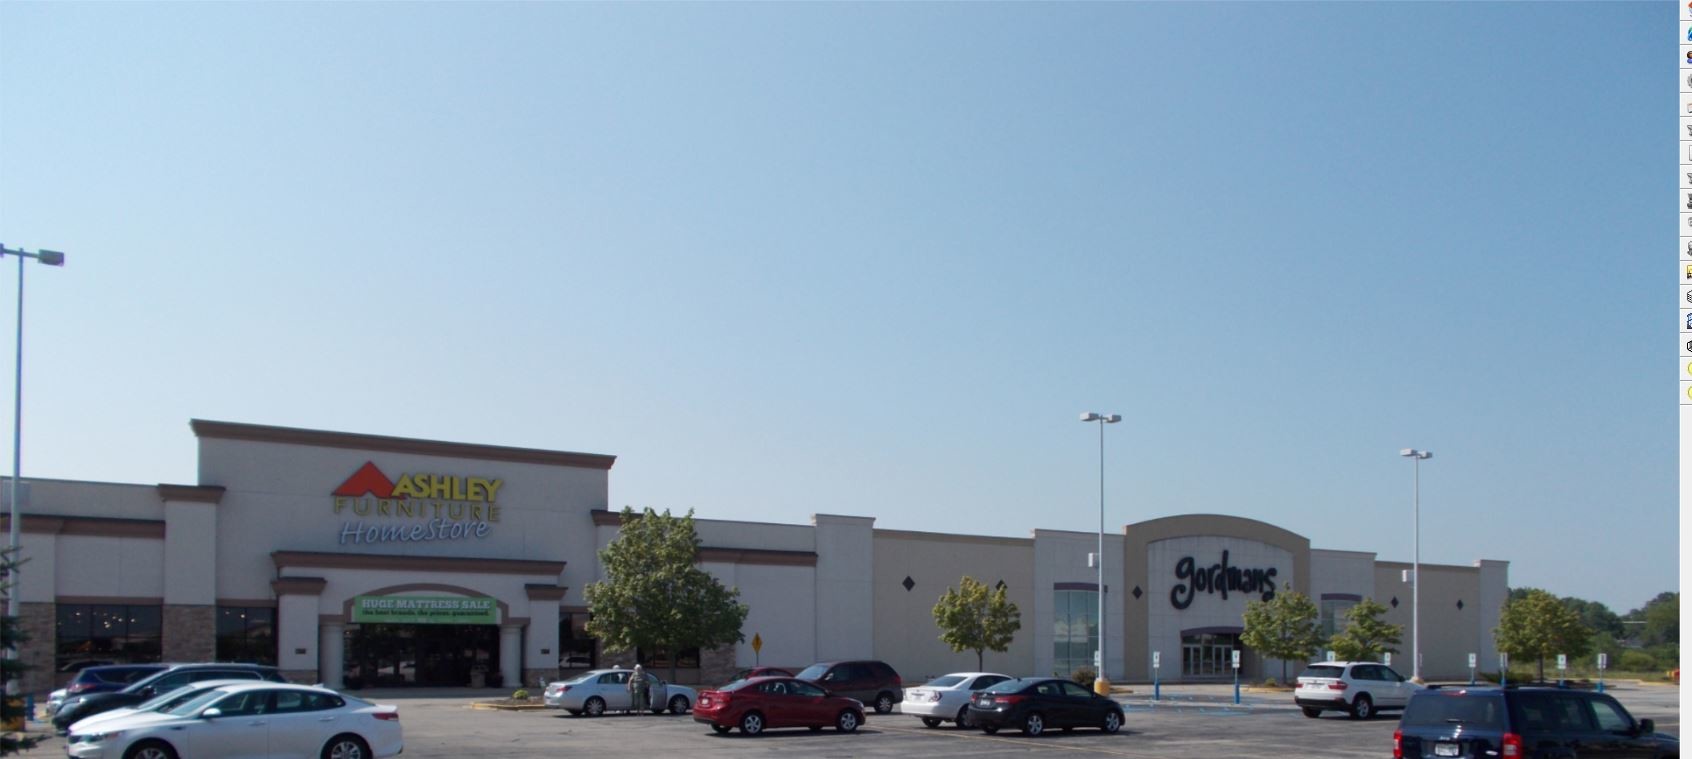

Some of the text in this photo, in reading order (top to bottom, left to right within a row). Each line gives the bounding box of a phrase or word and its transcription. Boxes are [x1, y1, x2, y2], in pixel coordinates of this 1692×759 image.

[391, 473, 503, 502] ASHLEY
[333, 496, 501, 522] FURNITURE
[339, 518, 490, 545] HomeStore
[1170, 549, 1277, 609] gordmans
[362, 599, 491, 609] HUGE MATTRESS SALE
